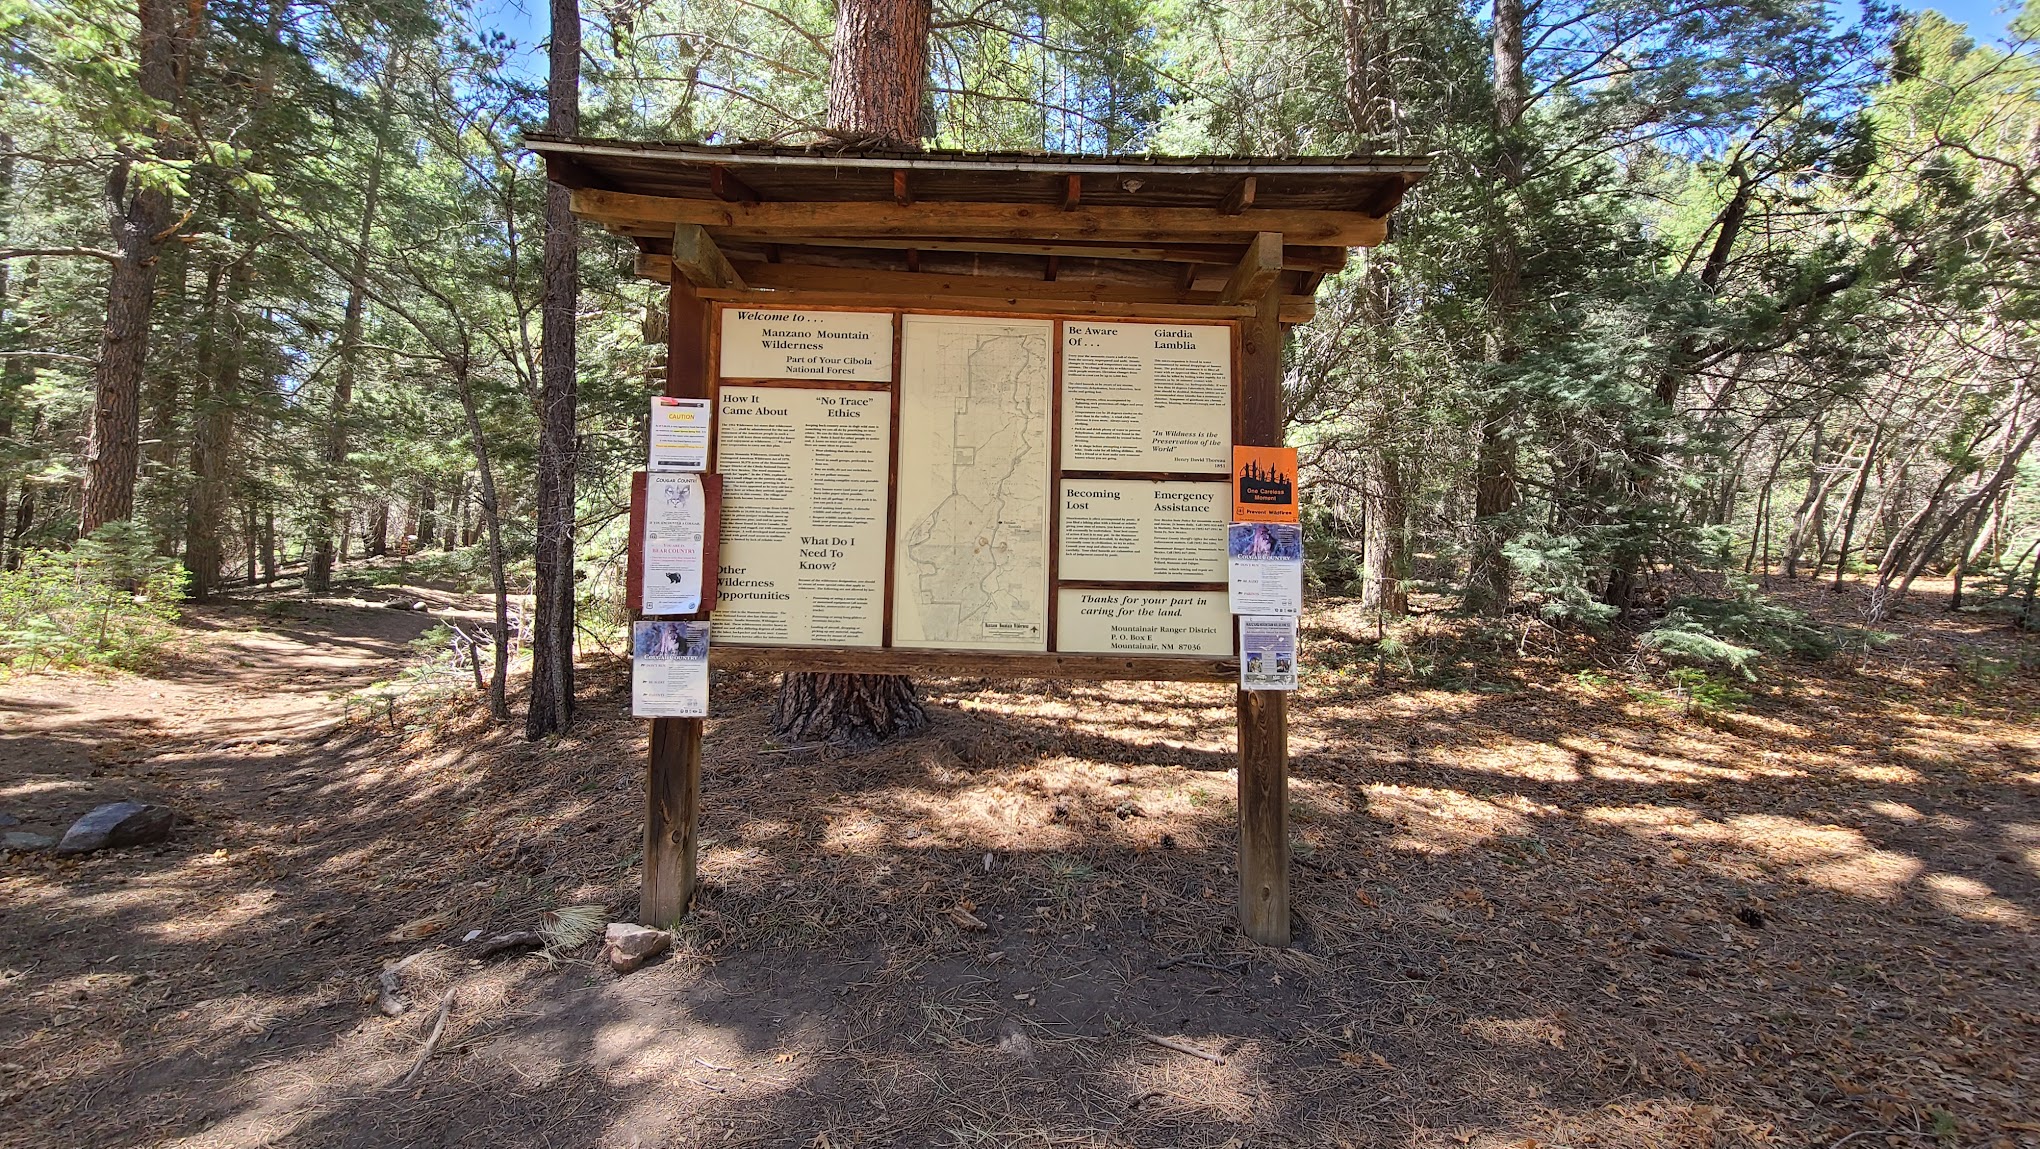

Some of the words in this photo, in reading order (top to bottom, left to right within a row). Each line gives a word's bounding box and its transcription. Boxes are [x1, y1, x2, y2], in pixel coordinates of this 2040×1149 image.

[738, 311, 789, 321] Welcome
[792, 313, 805, 322] to
[762, 328, 812, 338] Manzano
[817, 330, 869, 340] Mountain
[1069, 326, 1082, 335] Be
[1085, 326, 1118, 336] Aware
[1154, 329, 1193, 338] Giardia
[762, 340, 824, 350] Wilderness
[1068, 337, 1083, 347] Of
[1154, 341, 1196, 350] Lamblia
[819, 356, 841, 364] Your
[843, 357, 873, 365] Cibola
[786, 365, 824, 374] National
[827, 366, 855, 374] Forest
[723, 394, 748, 403] How
[751, 395, 760, 403] It
[722, 406, 753, 415] Came
[755, 406, 788, 416] About
[828, 409, 861, 418] Ethics
[1165, 430, 1197, 438] Wildness
[1152, 438, 1199, 446] Preservation
[1200, 439, 1210, 447] of
[1066, 488, 1121, 500] Becoming
[1154, 490, 1215, 503] Emergency
[1066, 501, 1089, 510] Lost
[1154, 502, 1210, 512] Assistance
[800, 536, 829, 545] What
[832, 537, 848, 546] Do
[850, 537, 856, 546] I
[799, 548, 827, 558] Need
[830, 549, 844, 558] To
[799, 561, 837, 571] Know?
[717, 577, 775, 587] Wilderness
[1081, 594, 1119, 604] Thanks
[1120, 595, 1139, 606] for
[1140, 597, 1167, 606] your
[1169, 597, 1193, 607] part
[1196, 597, 1207, 605] in
[1080, 606, 1114, 617] caring
[1115, 607, 1135, 618] for
[1137, 607, 1154, 616] the
[1157, 608, 1182, 617] land.
[1111, 625, 1158, 633] Mountainair
[1160, 626, 1187, 634] Ranger
[1189, 626, 1217, 634] District
[1111, 642, 1159, 650] Mountainair,
[1178, 643, 1201, 651] 87036
